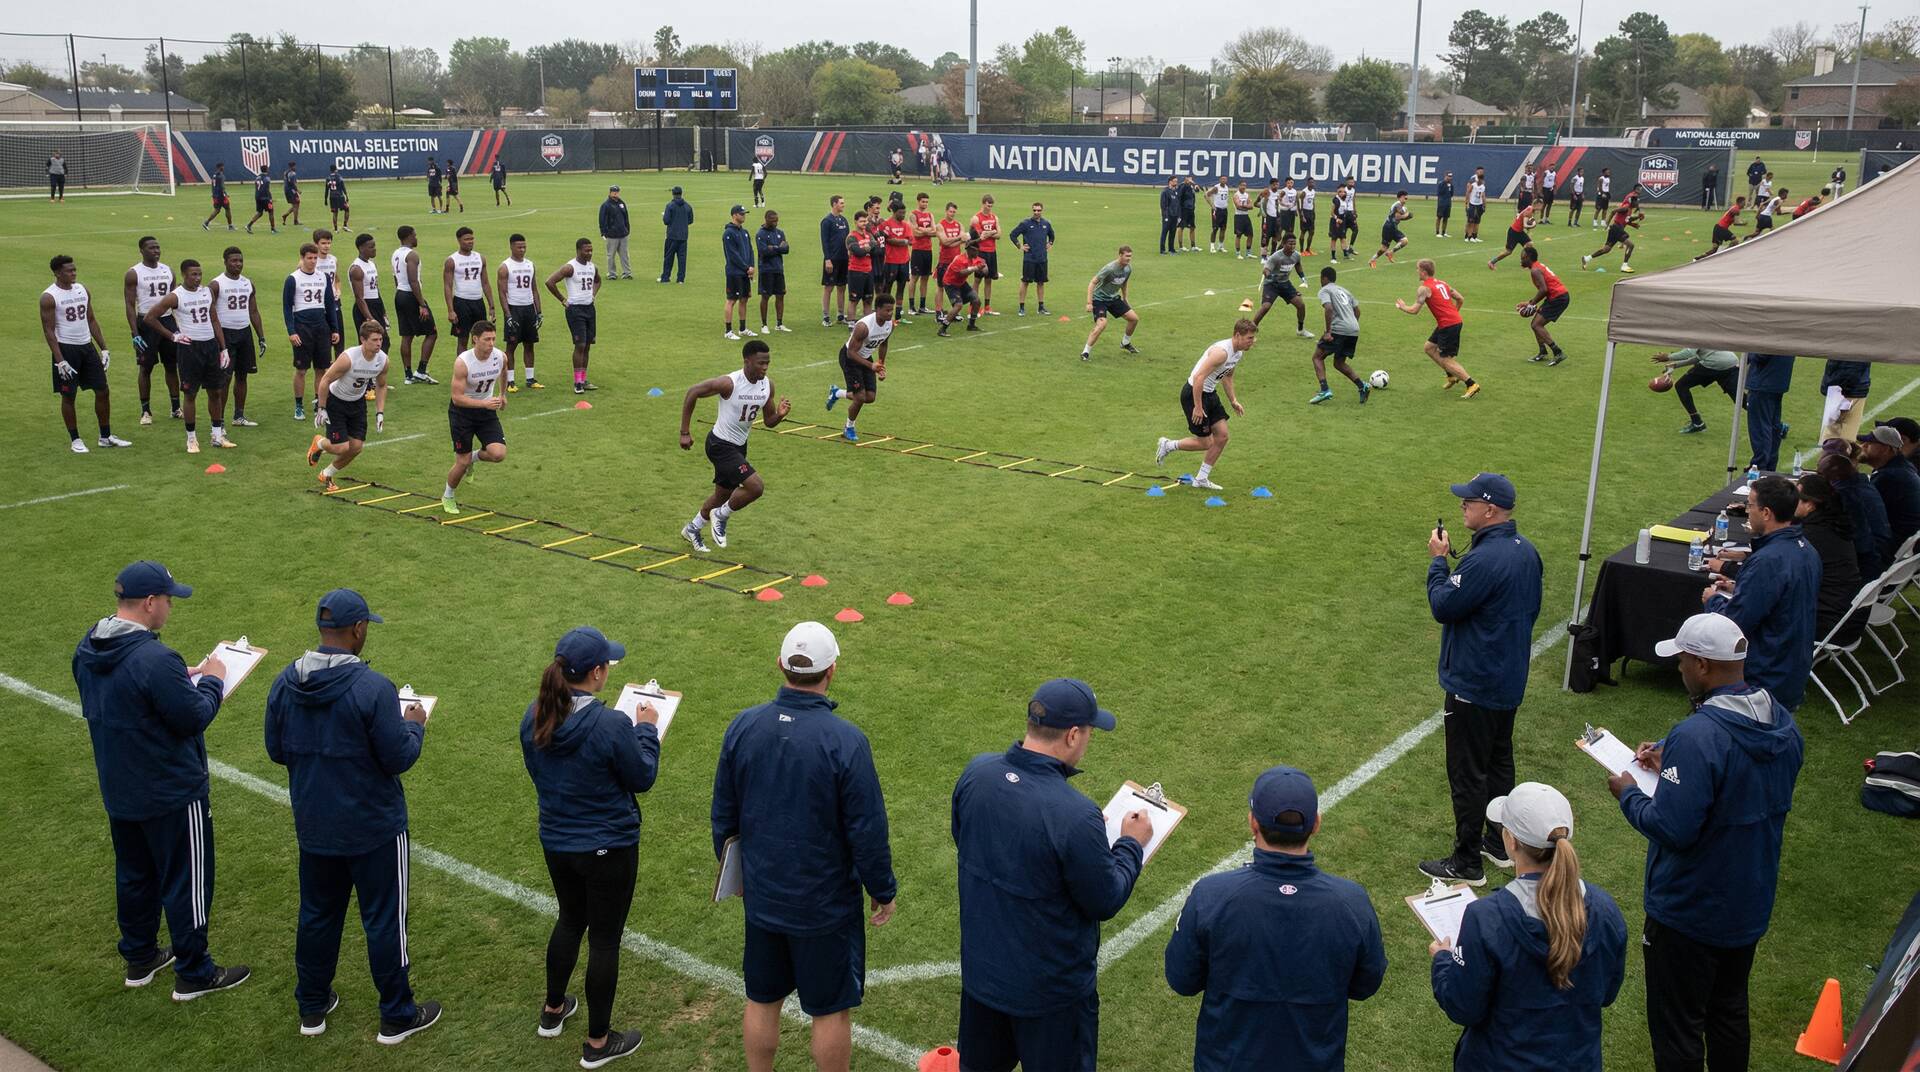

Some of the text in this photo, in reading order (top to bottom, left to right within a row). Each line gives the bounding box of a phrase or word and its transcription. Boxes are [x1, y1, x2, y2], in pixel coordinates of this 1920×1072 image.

[1675, 131, 1760, 140] NATIONAL SELECTION
[289, 138, 438, 154] NATIONAL SELECTION
[335, 155, 399, 170] COMBINE
[989, 144, 1440, 184] NATIONAL SELECTION COMBINE
[464, 267, 480, 280] 17
[149, 282, 167, 297] 19
[303, 289, 323, 303] 34
[228, 295, 248, 310] 32
